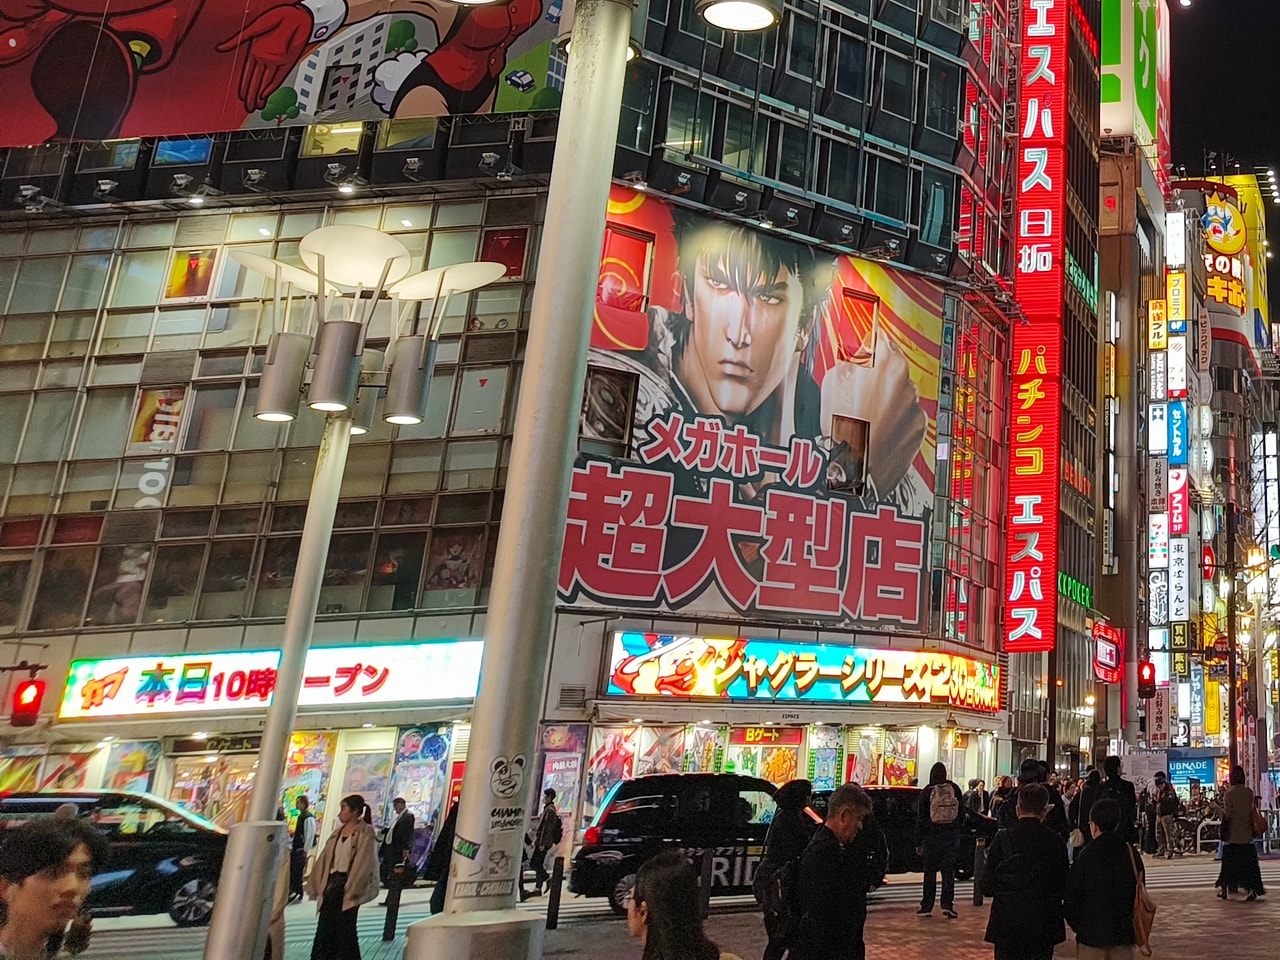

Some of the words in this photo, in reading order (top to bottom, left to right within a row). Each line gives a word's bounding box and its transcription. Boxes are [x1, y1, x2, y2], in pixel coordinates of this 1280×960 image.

[1171, 278, 1182, 317] プロミス
[1015, 345, 1047, 476] パチンコ
[1171, 409, 1183, 458] セントラル
[640, 413, 827, 488] メガホール
[1064, 461, 1093, 499] BEAUTY
[1172, 493, 1183, 522] アコム
[558, 461, 928, 626] 超大型店
[1008, 495, 1043, 641] エスパス
[135, 660, 390, 707] 本日10時ープン
[708, 647, 928, 700] ジャグラーシリーズ
[1190, 670, 1203, 724] じゃんぱら
[745, 728, 780, 743] Bゲート
[1169, 761, 1207, 771] UBNADE
